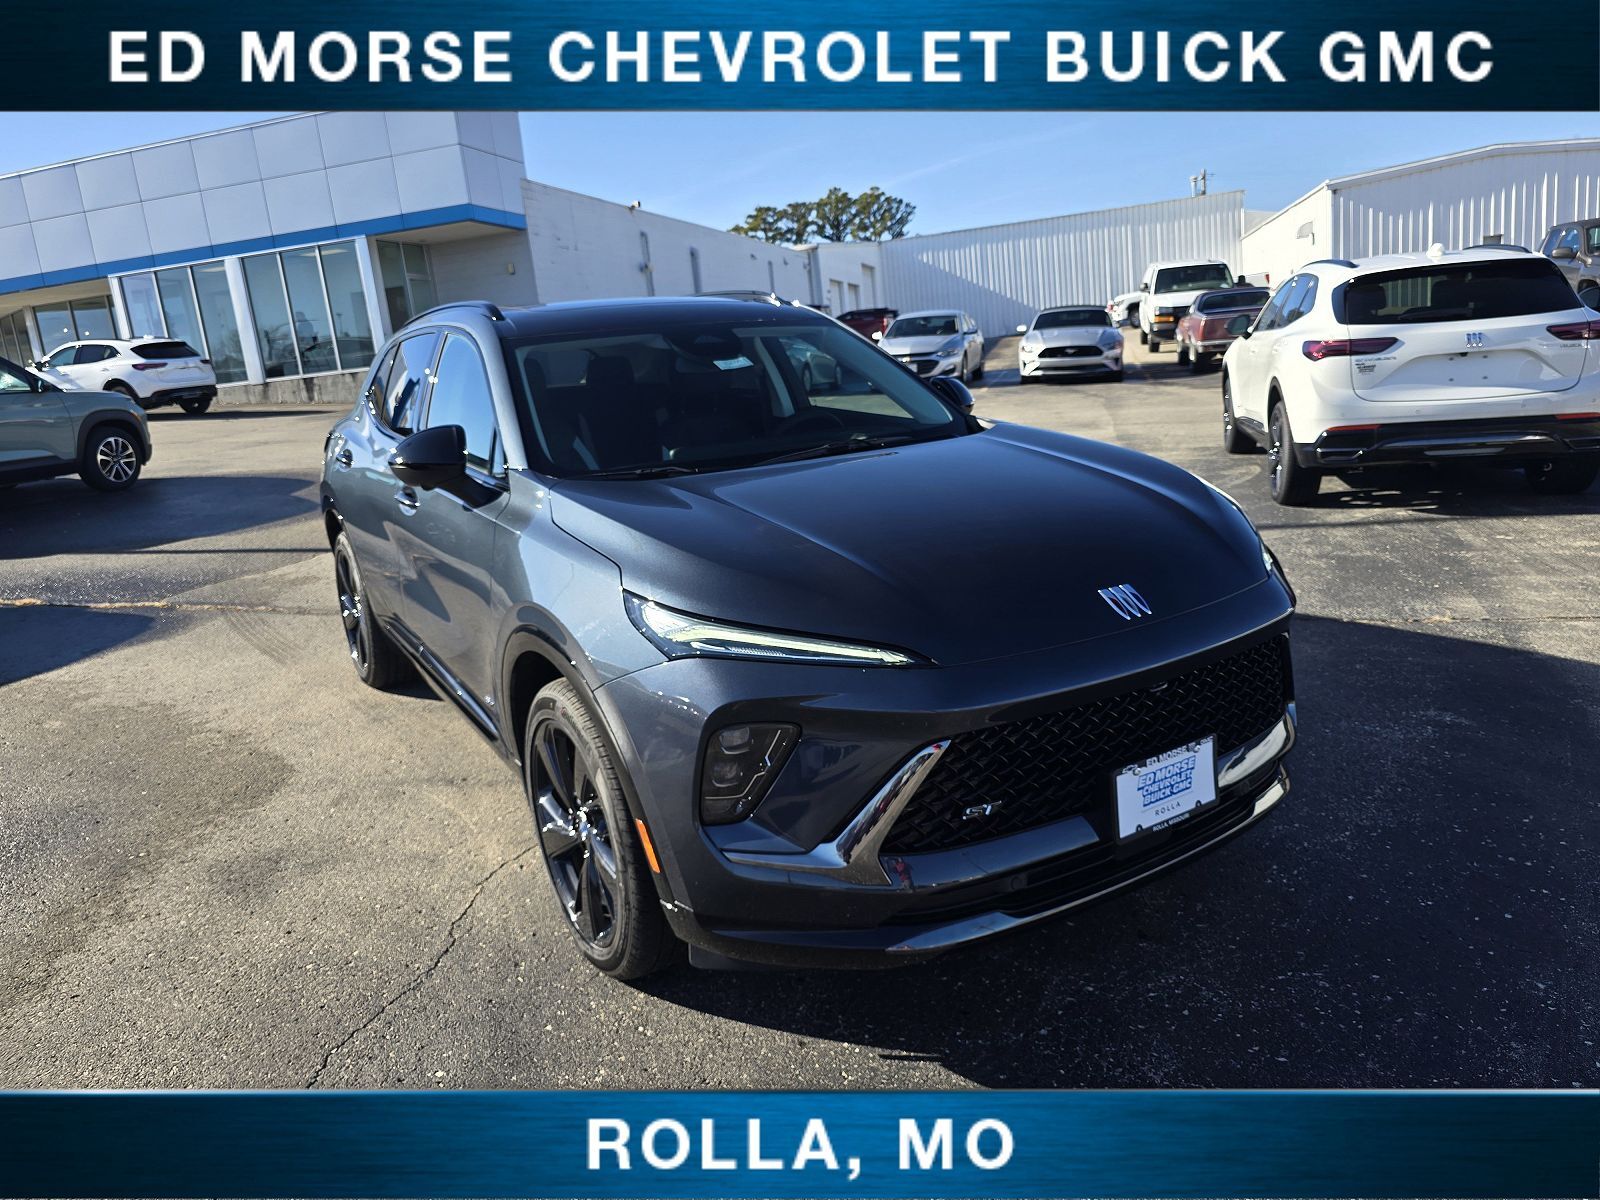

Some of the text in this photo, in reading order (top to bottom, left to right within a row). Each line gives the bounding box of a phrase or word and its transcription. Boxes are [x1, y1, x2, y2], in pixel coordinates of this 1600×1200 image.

[1146, 746, 1187, 767] ED MORSE
[1139, 757, 1196, 788] ED MORSE
[1142, 771, 1192, 796] CHEVROLET
[1143, 779, 1192, 806] BUICK GMC
[962, 800, 1002, 821] ST
[1154, 801, 1181, 816] ROLLA
